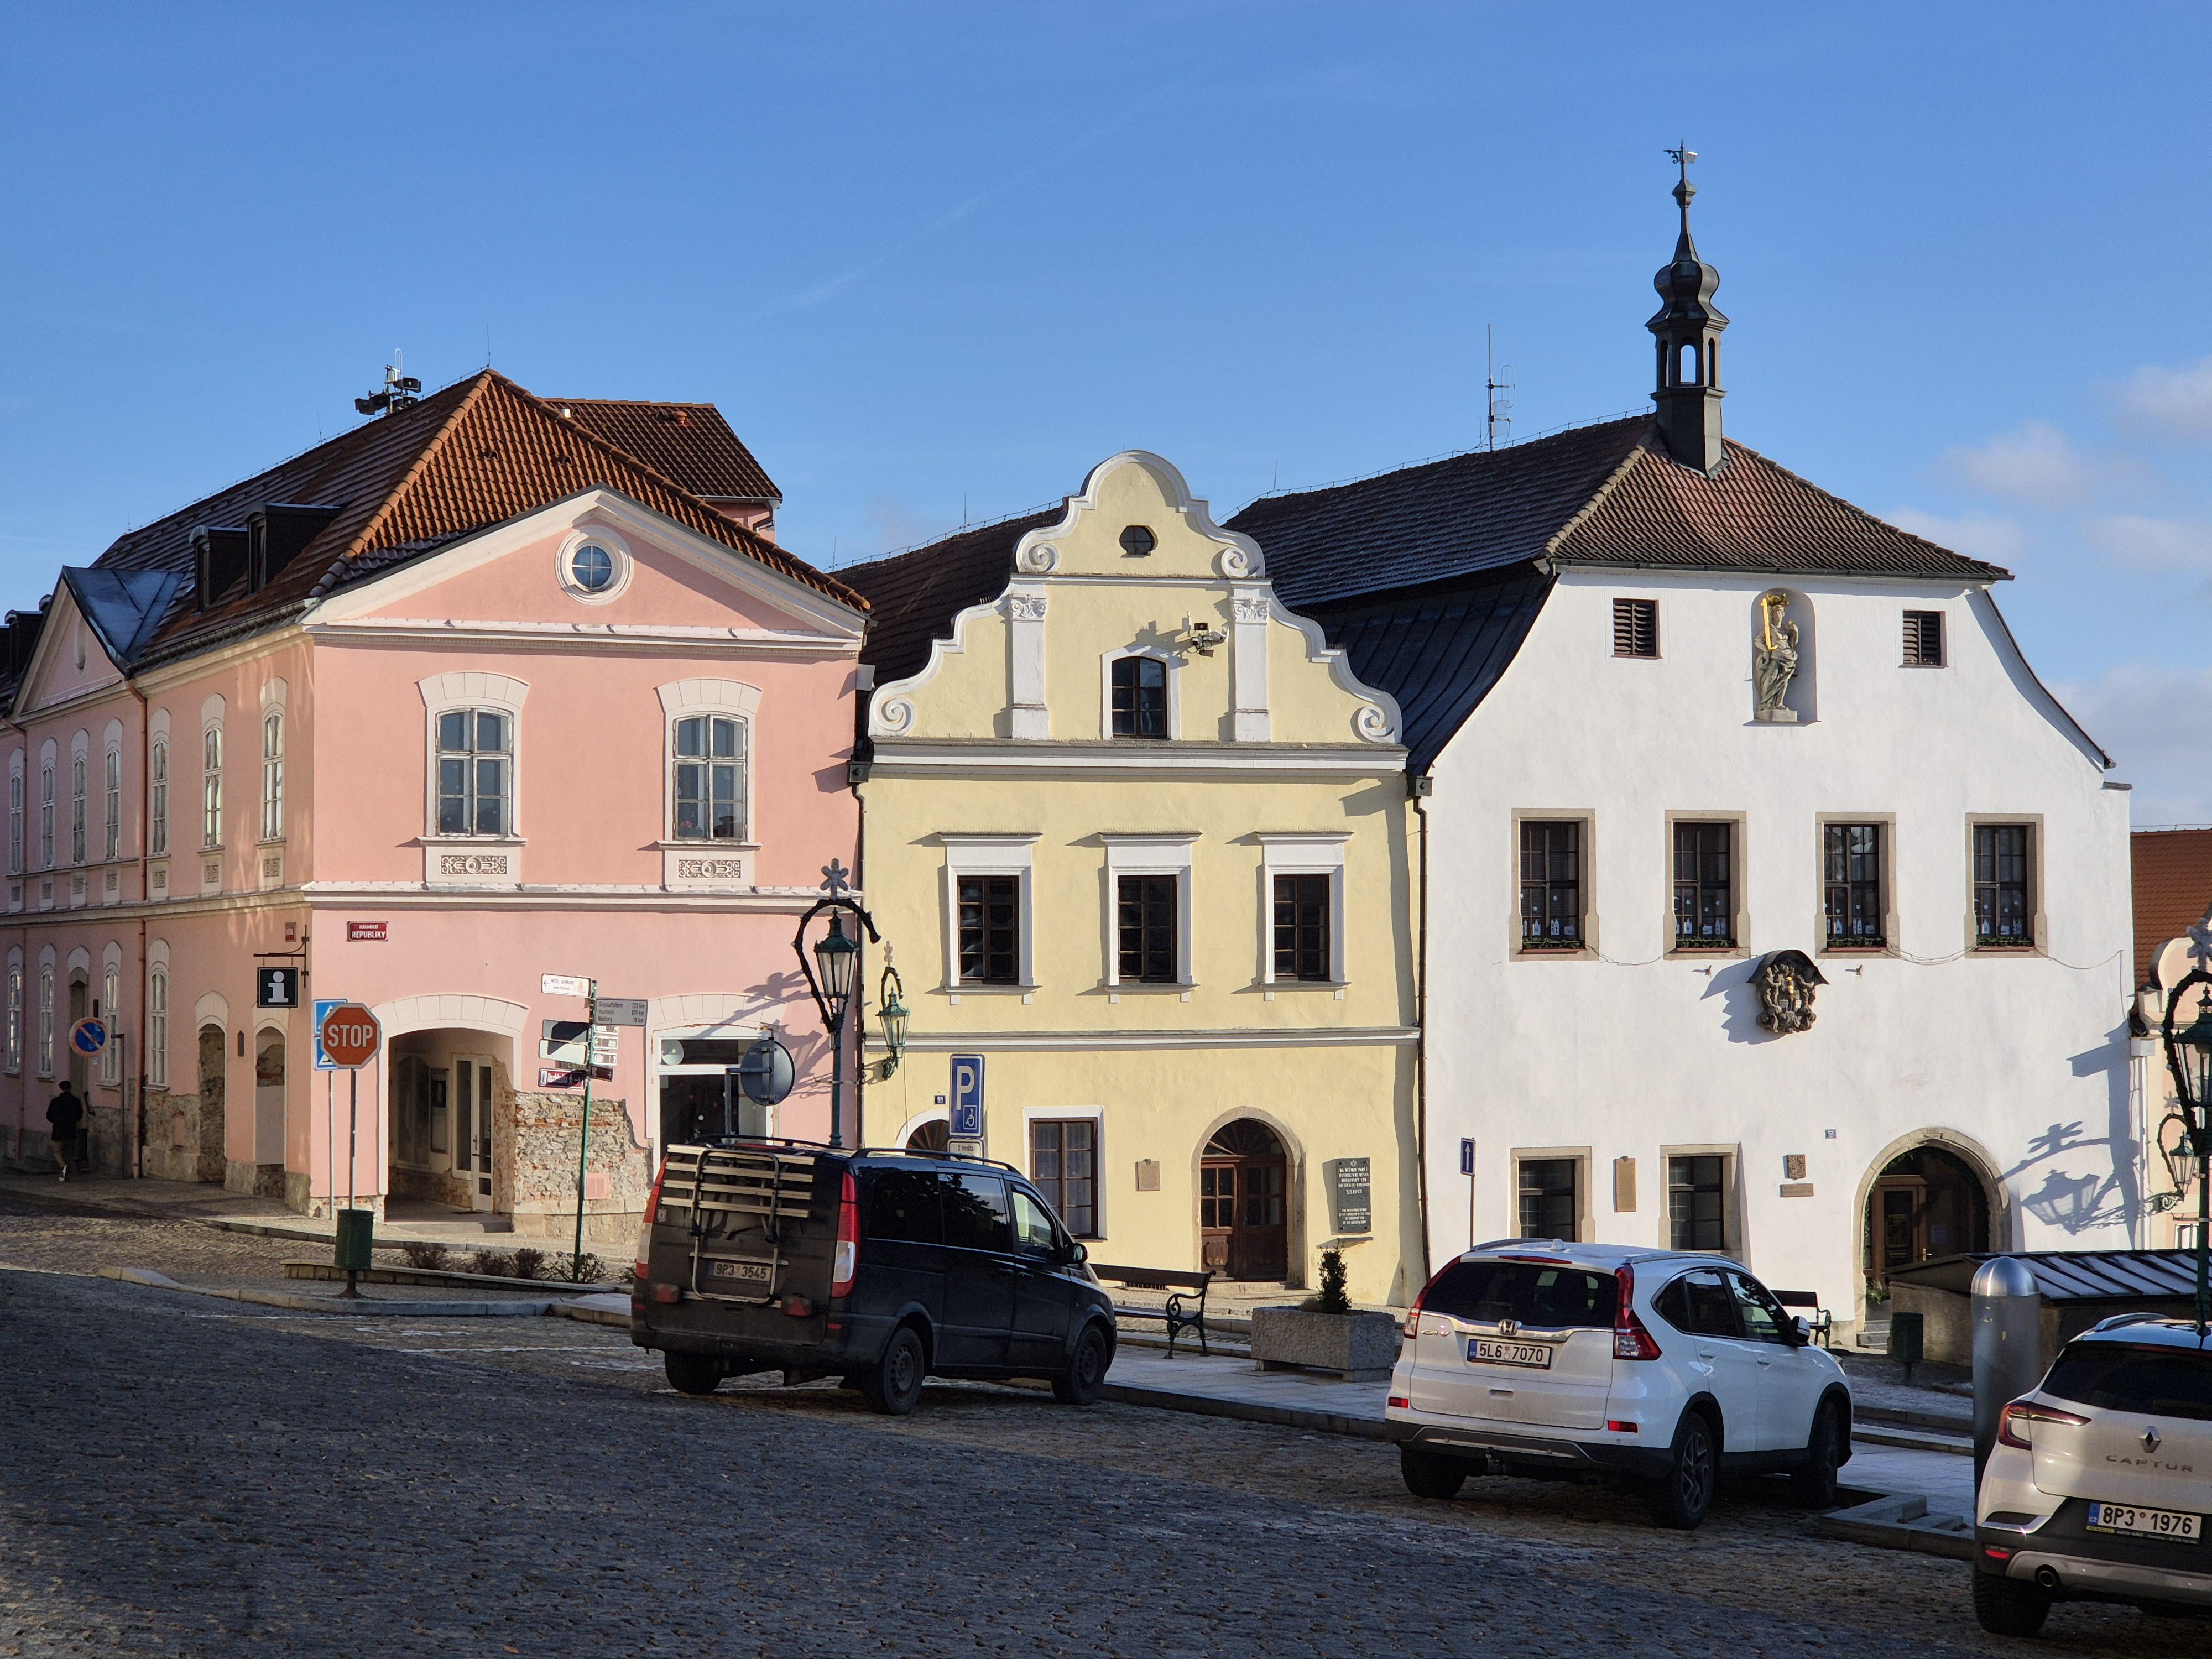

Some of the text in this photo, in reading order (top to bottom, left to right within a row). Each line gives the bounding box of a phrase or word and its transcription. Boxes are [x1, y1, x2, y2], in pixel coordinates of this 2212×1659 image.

[328, 1024, 373, 1047] STOP
[956, 1066, 974, 1110] P
[716, 1264, 767, 1279] 9P3 3545
[1479, 1343, 1543, 1363] 5L6 7070
[2106, 1454, 2193, 1472] CAPTUR
[2103, 1507, 2193, 1535] 8P3 1976
